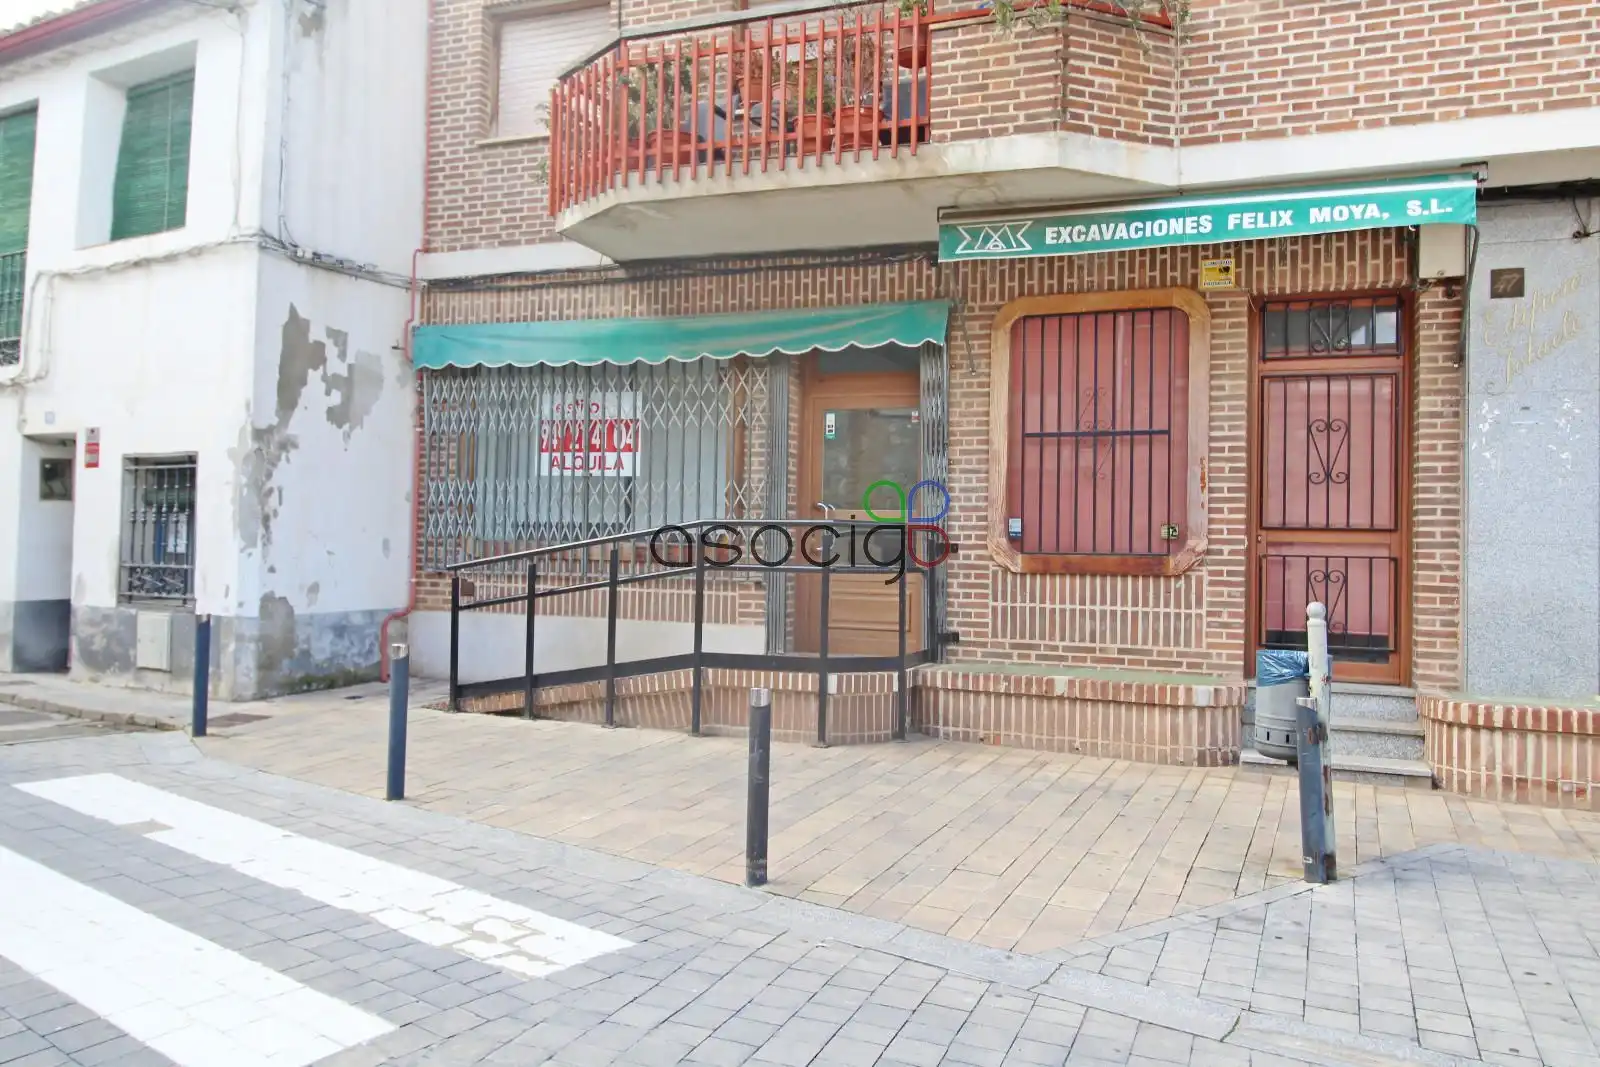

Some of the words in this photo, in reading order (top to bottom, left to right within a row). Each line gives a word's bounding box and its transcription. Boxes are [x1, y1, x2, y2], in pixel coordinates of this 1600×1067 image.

[1045, 215, 1212, 245] EXCAVACIONES
[1227, 210, 1294, 231] FELIX
[1310, 203, 1390, 224] MOYA,
[1406, 198, 1453, 217] S.L.
[551, 455, 624, 470] ALQUILA
